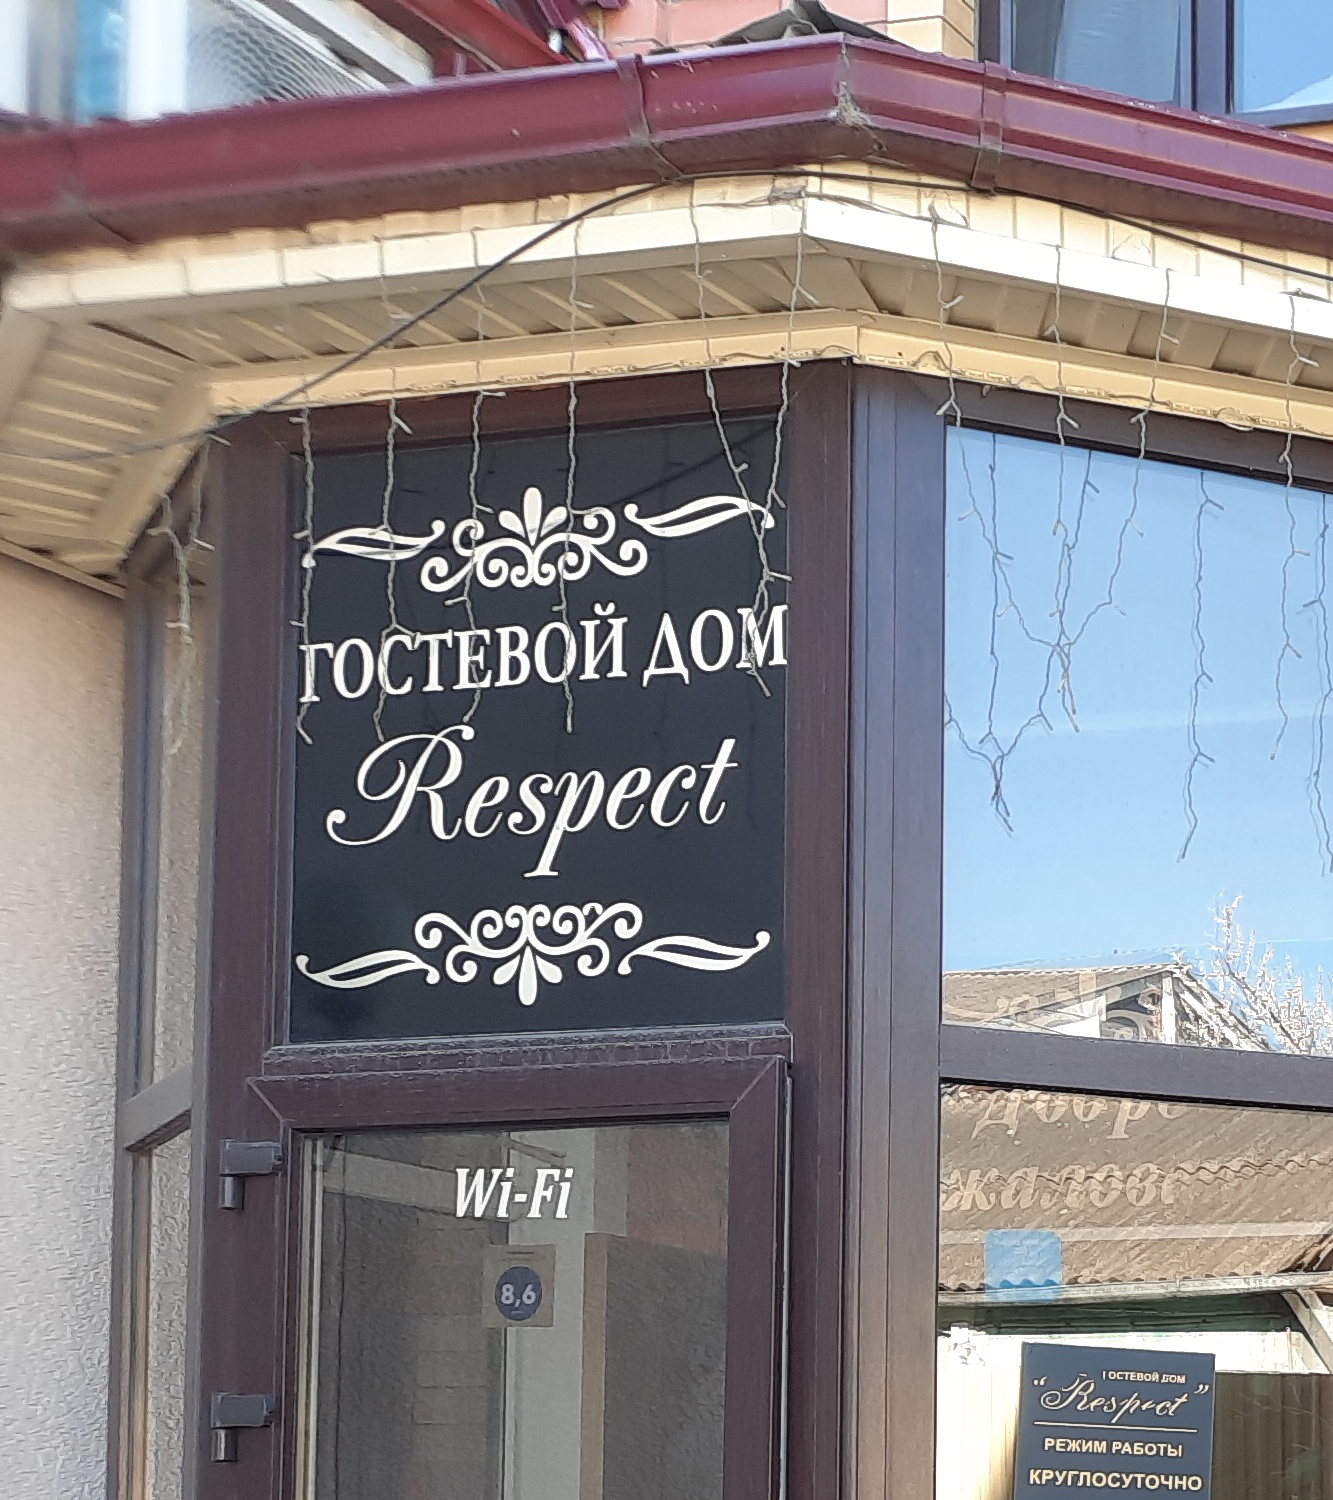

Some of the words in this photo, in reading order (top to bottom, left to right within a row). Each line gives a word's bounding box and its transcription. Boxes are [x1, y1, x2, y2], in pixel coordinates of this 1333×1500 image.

[299, 602, 628, 703] ГОСТЕВОЙ
[641, 604, 789, 687] ДОМ
[325, 723, 739, 878] Respect
[455, 1167, 574, 1219] Wi-Fi
[501, 1282, 537, 1308] 8,6
[1161, 1374, 1186, 1384] ДОМ
[1044, 1437, 1107, 1454] РЕЖИМ
[1112, 1441, 1183, 1457] РАБОТЫ
[1028, 1469, 1203, 1491] КРУГЛОСУТОЧНО
